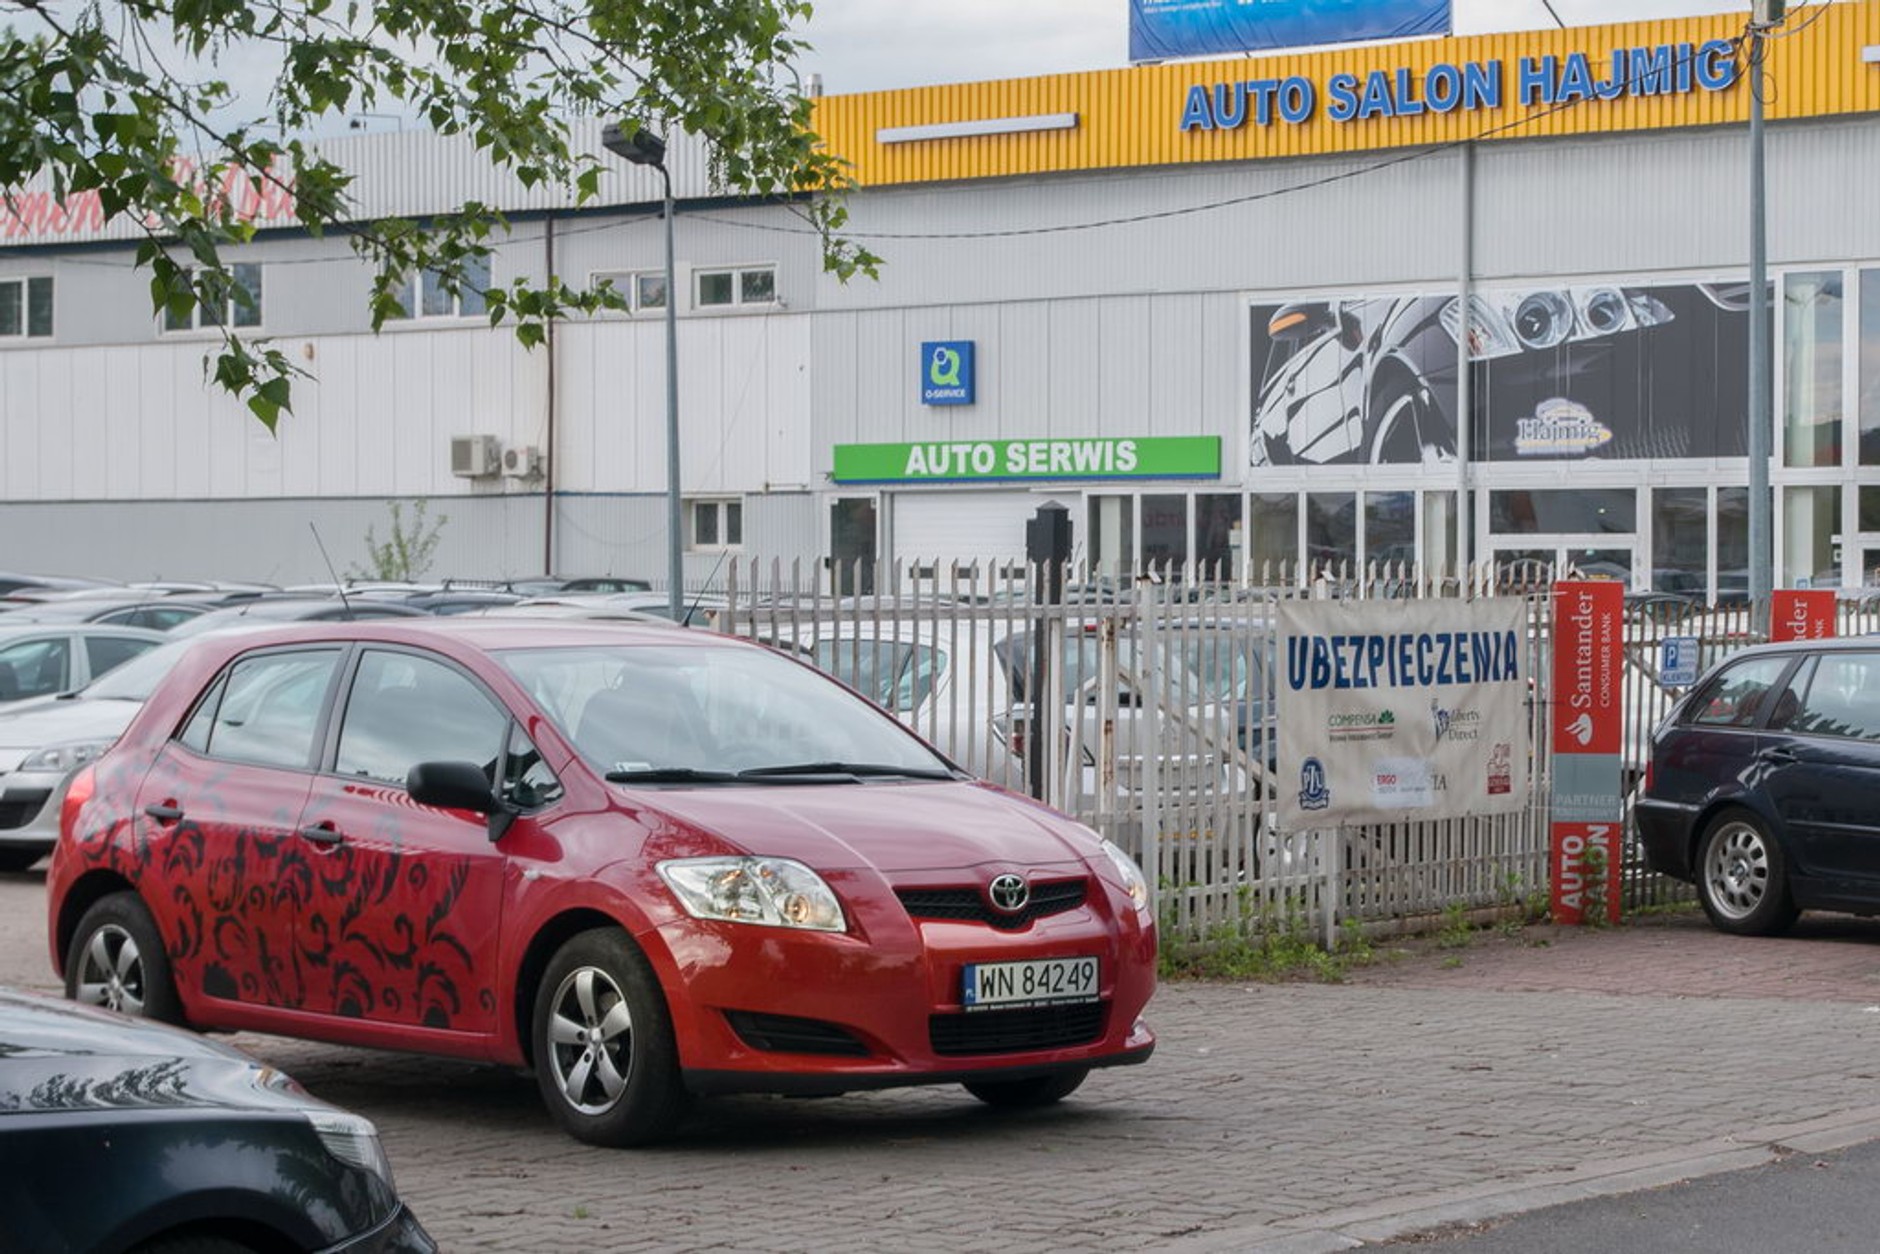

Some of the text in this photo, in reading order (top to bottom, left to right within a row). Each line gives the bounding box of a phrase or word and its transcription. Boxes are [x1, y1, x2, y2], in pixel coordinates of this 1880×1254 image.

[1180, 39, 1735, 131] AUTO SALON HAJMIG
[1520, 420, 1600, 443] Hajmig
[905, 440, 1137, 475] AUTO SERWIS
[1288, 630, 1518, 691] UBEZPIECZENIA
[1570, 591, 1593, 708] Santander
[1601, 612, 1612, 708] CONSUMER BANK
[1667, 645, 1675, 666] P
[1328, 713, 1376, 727] COMPENSA
[1449, 729, 1478, 741] Direct
[1556, 794, 1618, 807] PARTNER
[1561, 835, 1584, 910] AUTO
[980, 961, 1095, 998] WN 84249
